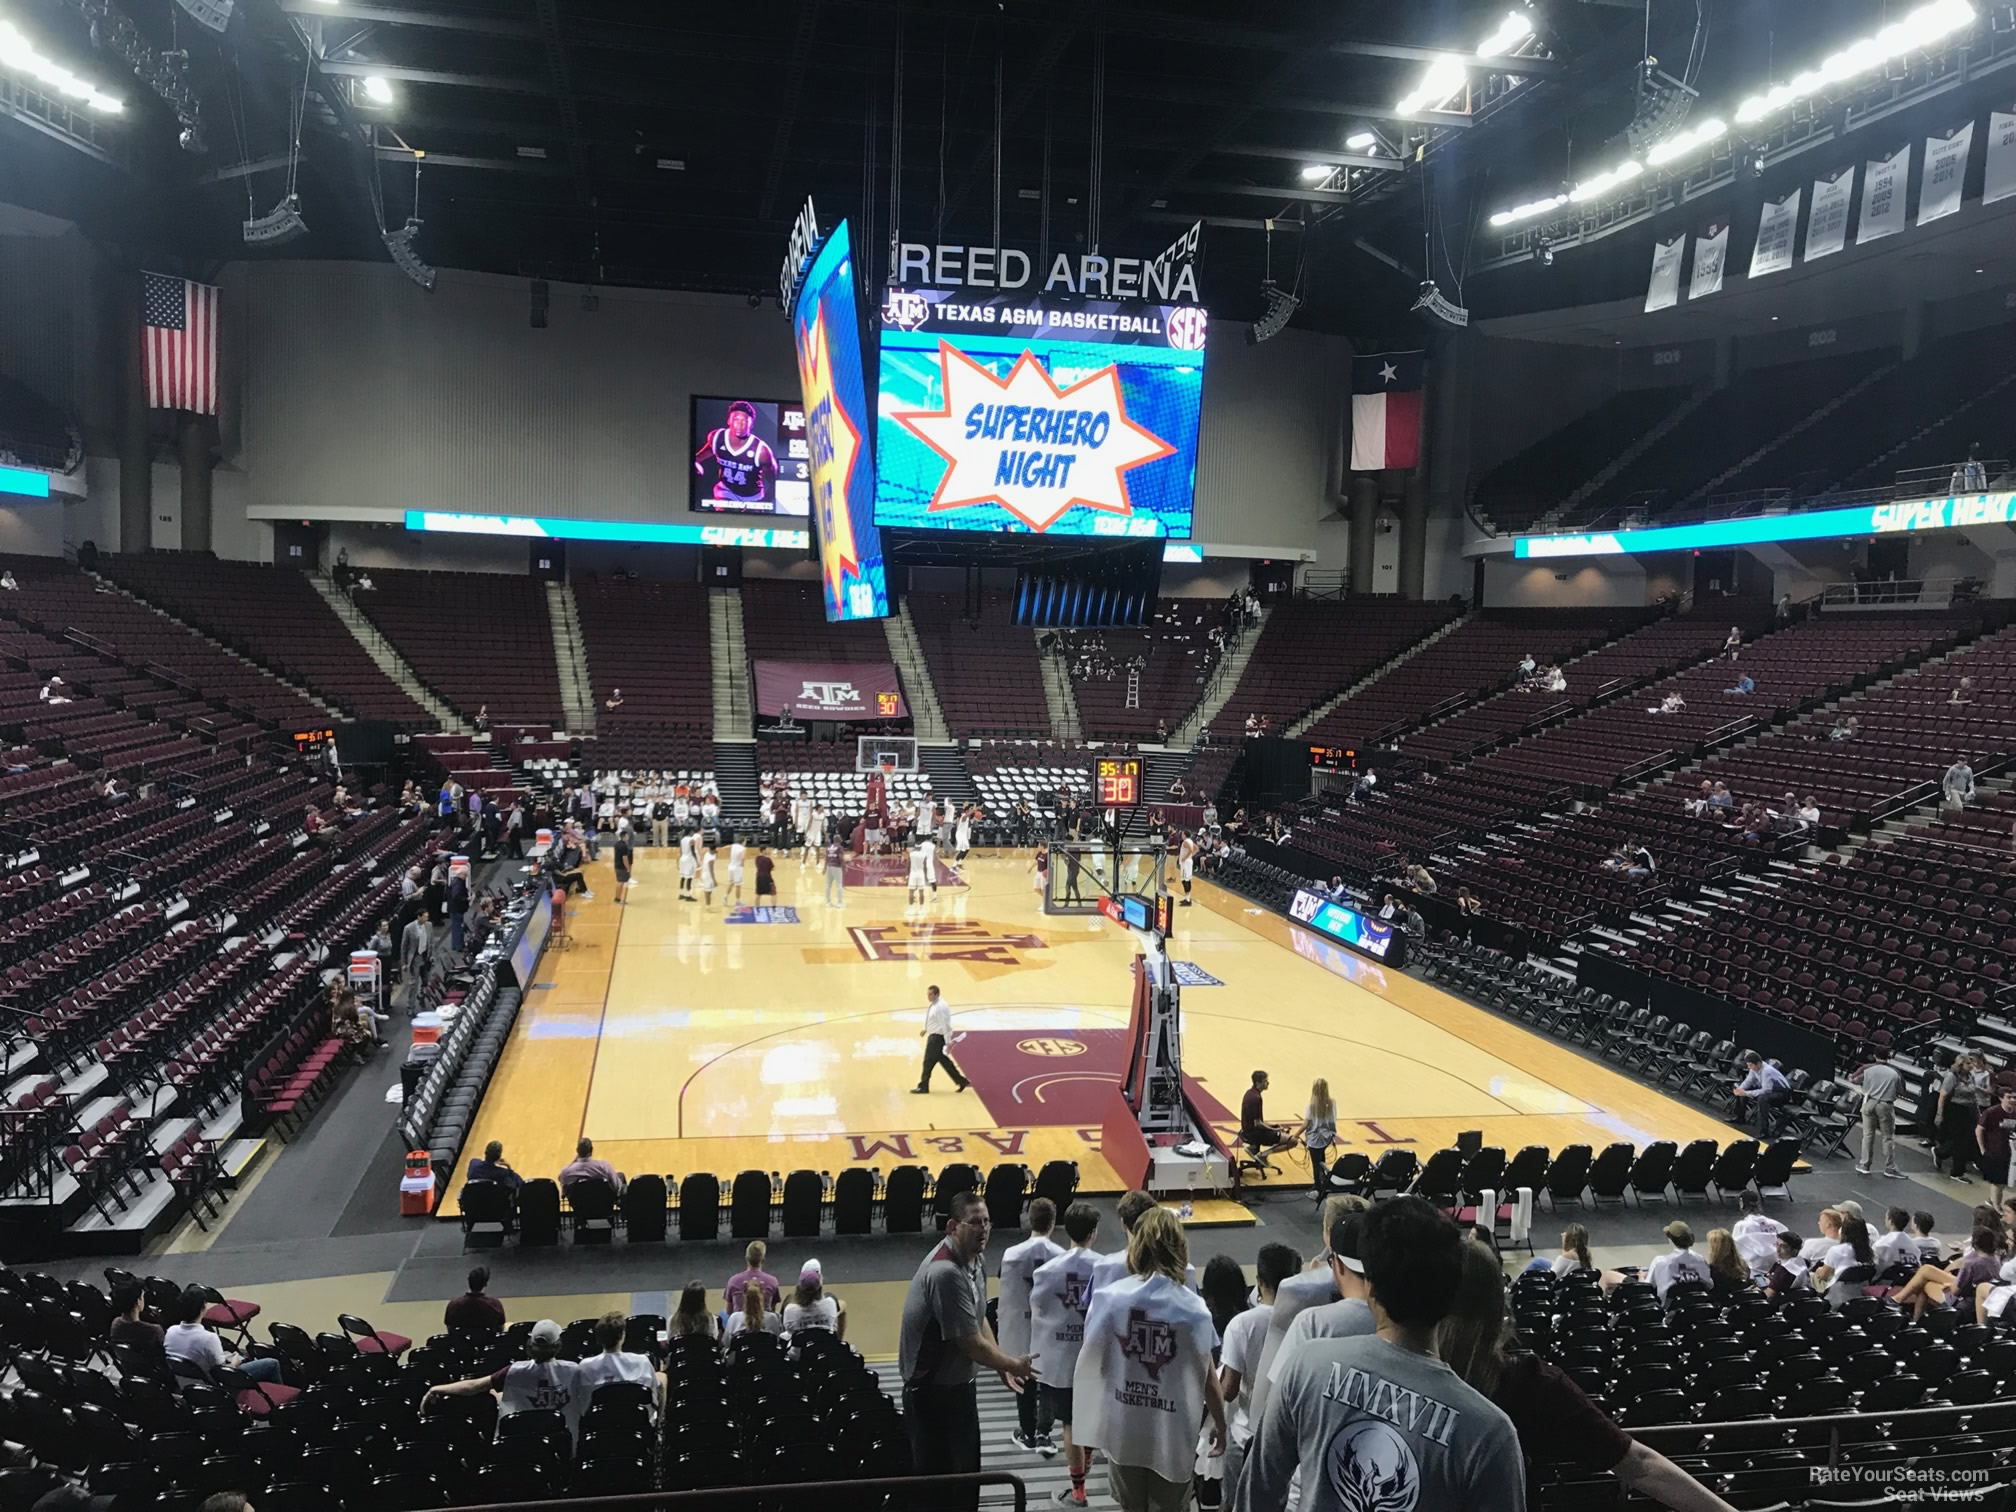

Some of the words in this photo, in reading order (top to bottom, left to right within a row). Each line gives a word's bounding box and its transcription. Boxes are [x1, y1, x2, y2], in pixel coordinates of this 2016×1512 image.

[1871, 202, 1890, 217] 2012
[900, 243, 1031, 288] REED
[1044, 253, 1199, 302] ARENA
[935, 304, 996, 323] TEXAS
[1000, 307, 1043, 325] A&M
[1050, 311, 1161, 334] BASKETBALL
[1169, 307, 1208, 351] SEC
[1809, 329, 1837, 347] 202
[1654, 351, 1680, 365] 201
[965, 402, 1110, 449] SUPERHERO
[994, 449, 1076, 489] NIGHT
[1871, 499, 1949, 533] SUPER
[701, 527, 770, 547] SUPER
[880, 703, 895, 715] 30
[1100, 762, 1137, 776] 35:17
[1104, 778, 1132, 802] 30
[1125, 1380, 1159, 1395] MEN'S
[1115, 1389, 1176, 1413] BASKETBALL
[1322, 1361, 1460, 1447] MMXVII
